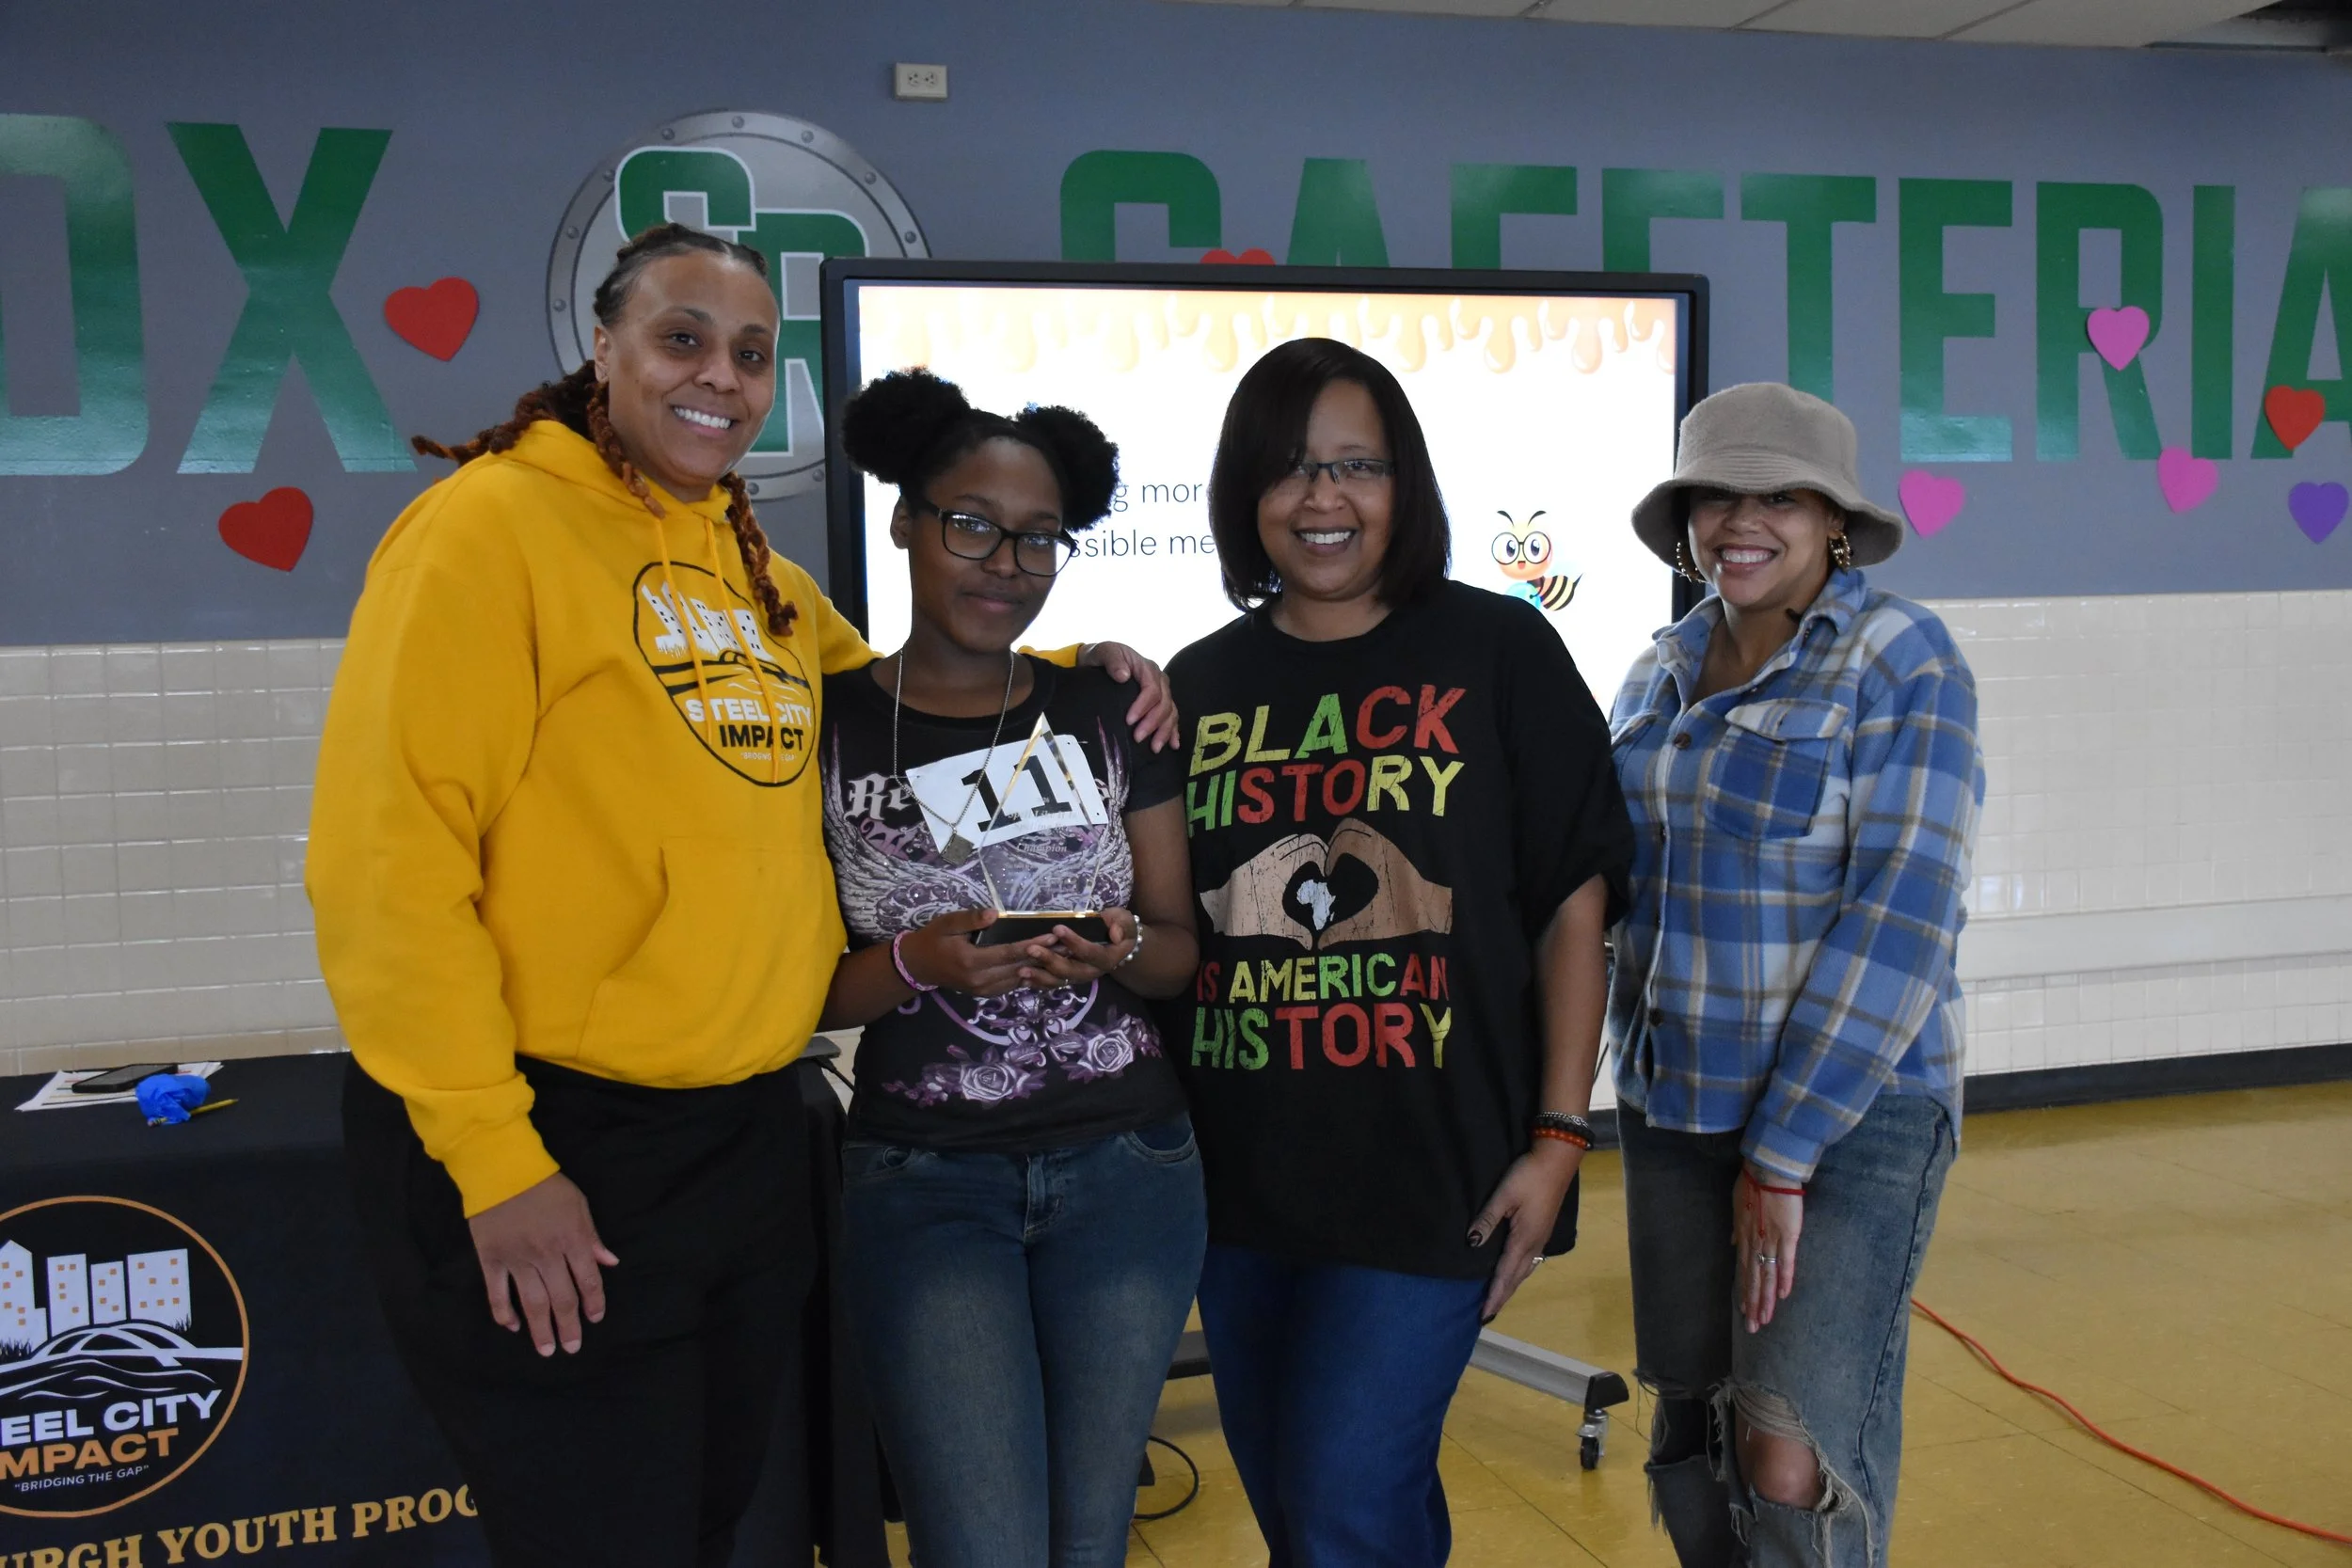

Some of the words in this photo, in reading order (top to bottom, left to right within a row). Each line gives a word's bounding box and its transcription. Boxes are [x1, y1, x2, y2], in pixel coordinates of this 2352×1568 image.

[1142, 483, 1206, 503] mor
[1071, 529, 1156, 558] ssible
[1169, 534, 1216, 555] me
[686, 698, 771, 722] STEEL
[1189, 684, 1467, 777] BLACK
[961, 753, 1071, 832] 11
[1186, 754, 1465, 839] HISTORY
[1197, 960, 1220, 1004] IS
[1229, 953, 1450, 1005] AMERICAN
[1191, 1003, 1452, 1070] HISTORY
[0, 1409, 94, 1447] EEL
[103, 1389, 222, 1432] CITY
[0, 1428, 179, 1480] MPACT
[15, 1474, 85, 1492] "BRIDGING
[89, 1468, 113, 1483] THE
[117, 1465, 150, 1478] GAP"
[157, 1507, 337, 1564] YOUTH
[352, 1483, 478, 1538] PROG
